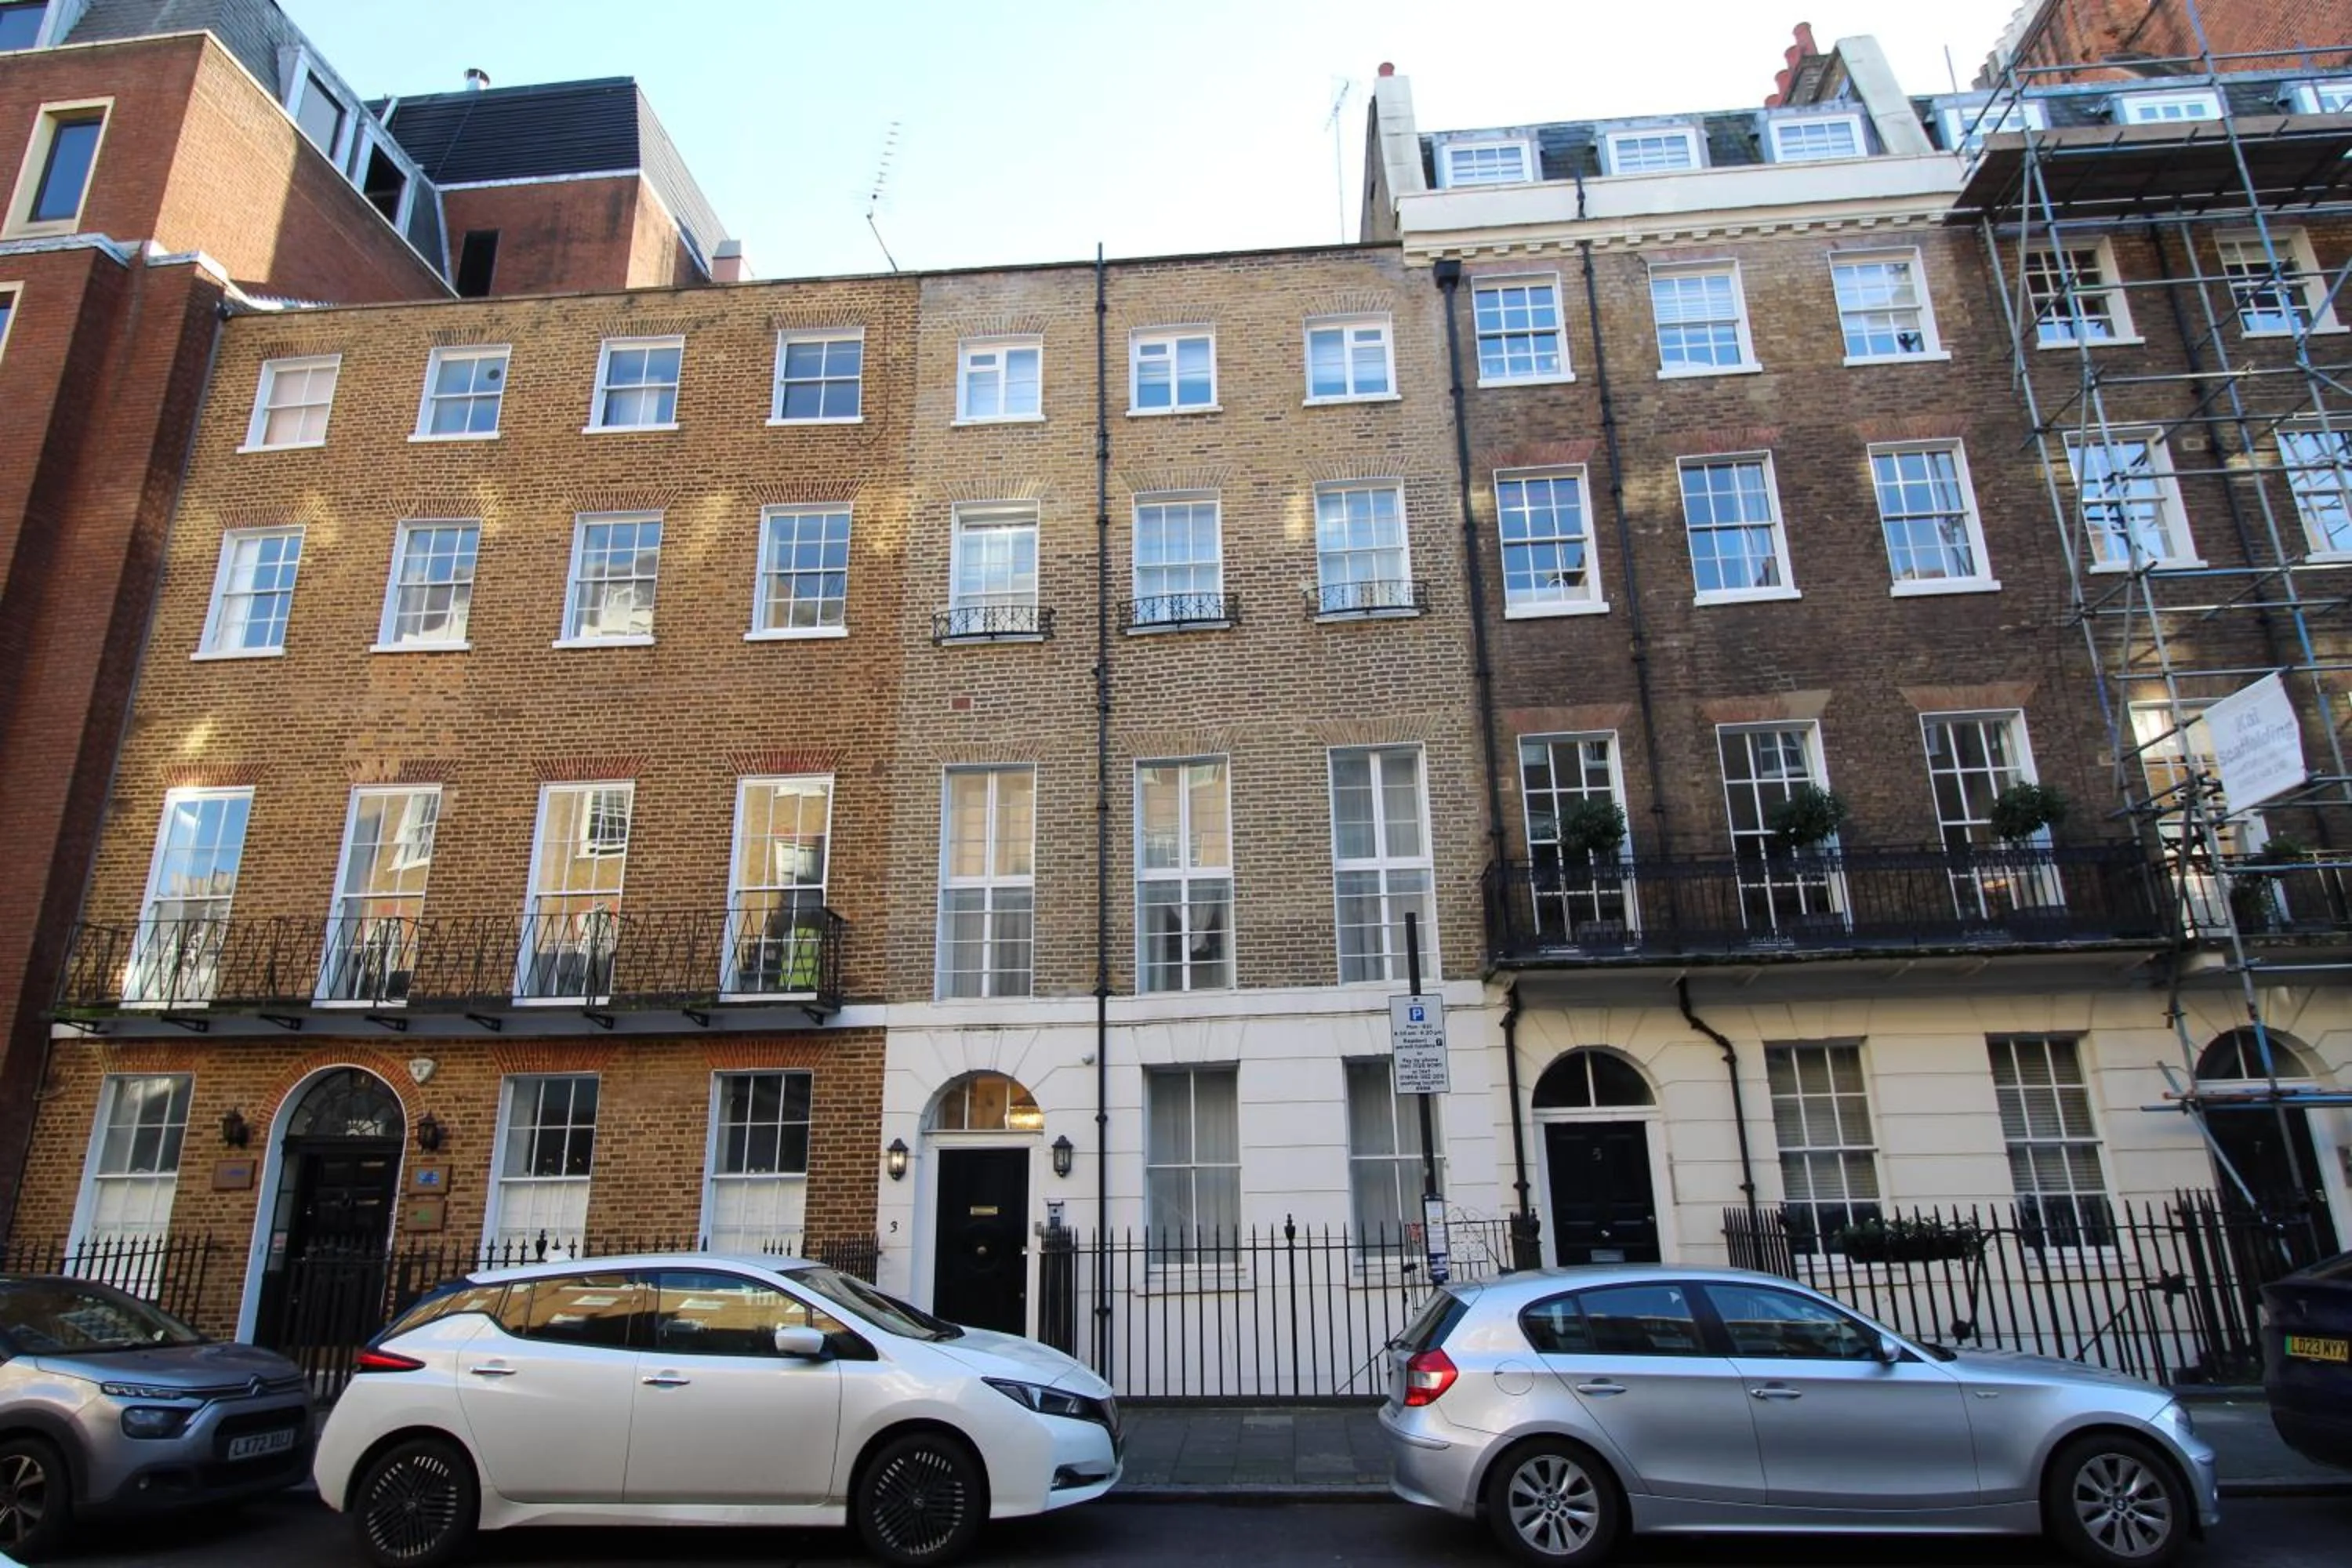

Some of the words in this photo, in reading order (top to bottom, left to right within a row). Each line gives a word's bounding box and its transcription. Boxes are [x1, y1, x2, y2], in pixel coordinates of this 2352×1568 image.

[1592, 1147, 1602, 1160] 5
[890, 1221, 898, 1233] 3
[2291, 1337, 2320, 1356] LD23
